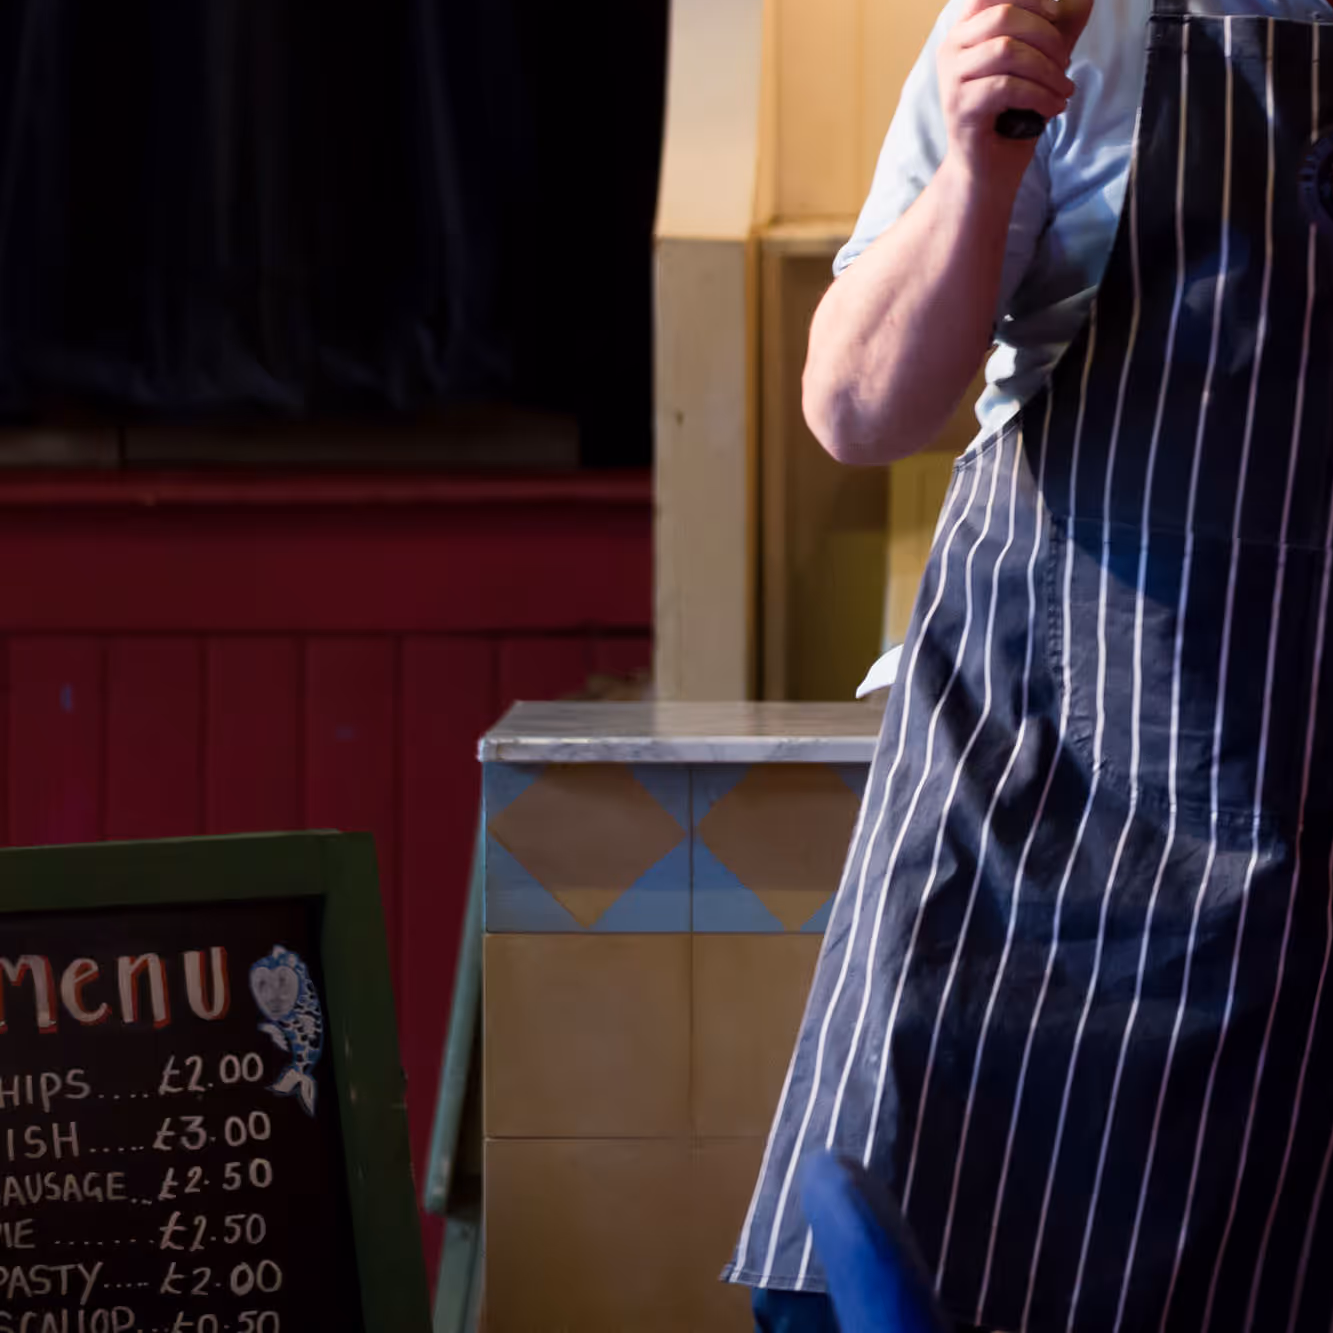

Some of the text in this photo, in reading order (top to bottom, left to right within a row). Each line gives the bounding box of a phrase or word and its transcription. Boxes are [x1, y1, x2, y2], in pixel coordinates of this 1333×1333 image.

[158, 1052, 264, 1097] £2.00
[153, 1111, 271, 1152] £3.00
[158, 1158, 273, 1201] £2.50
[160, 1211, 266, 1252] £2.50
[160, 1259, 283, 1297] £2.00
